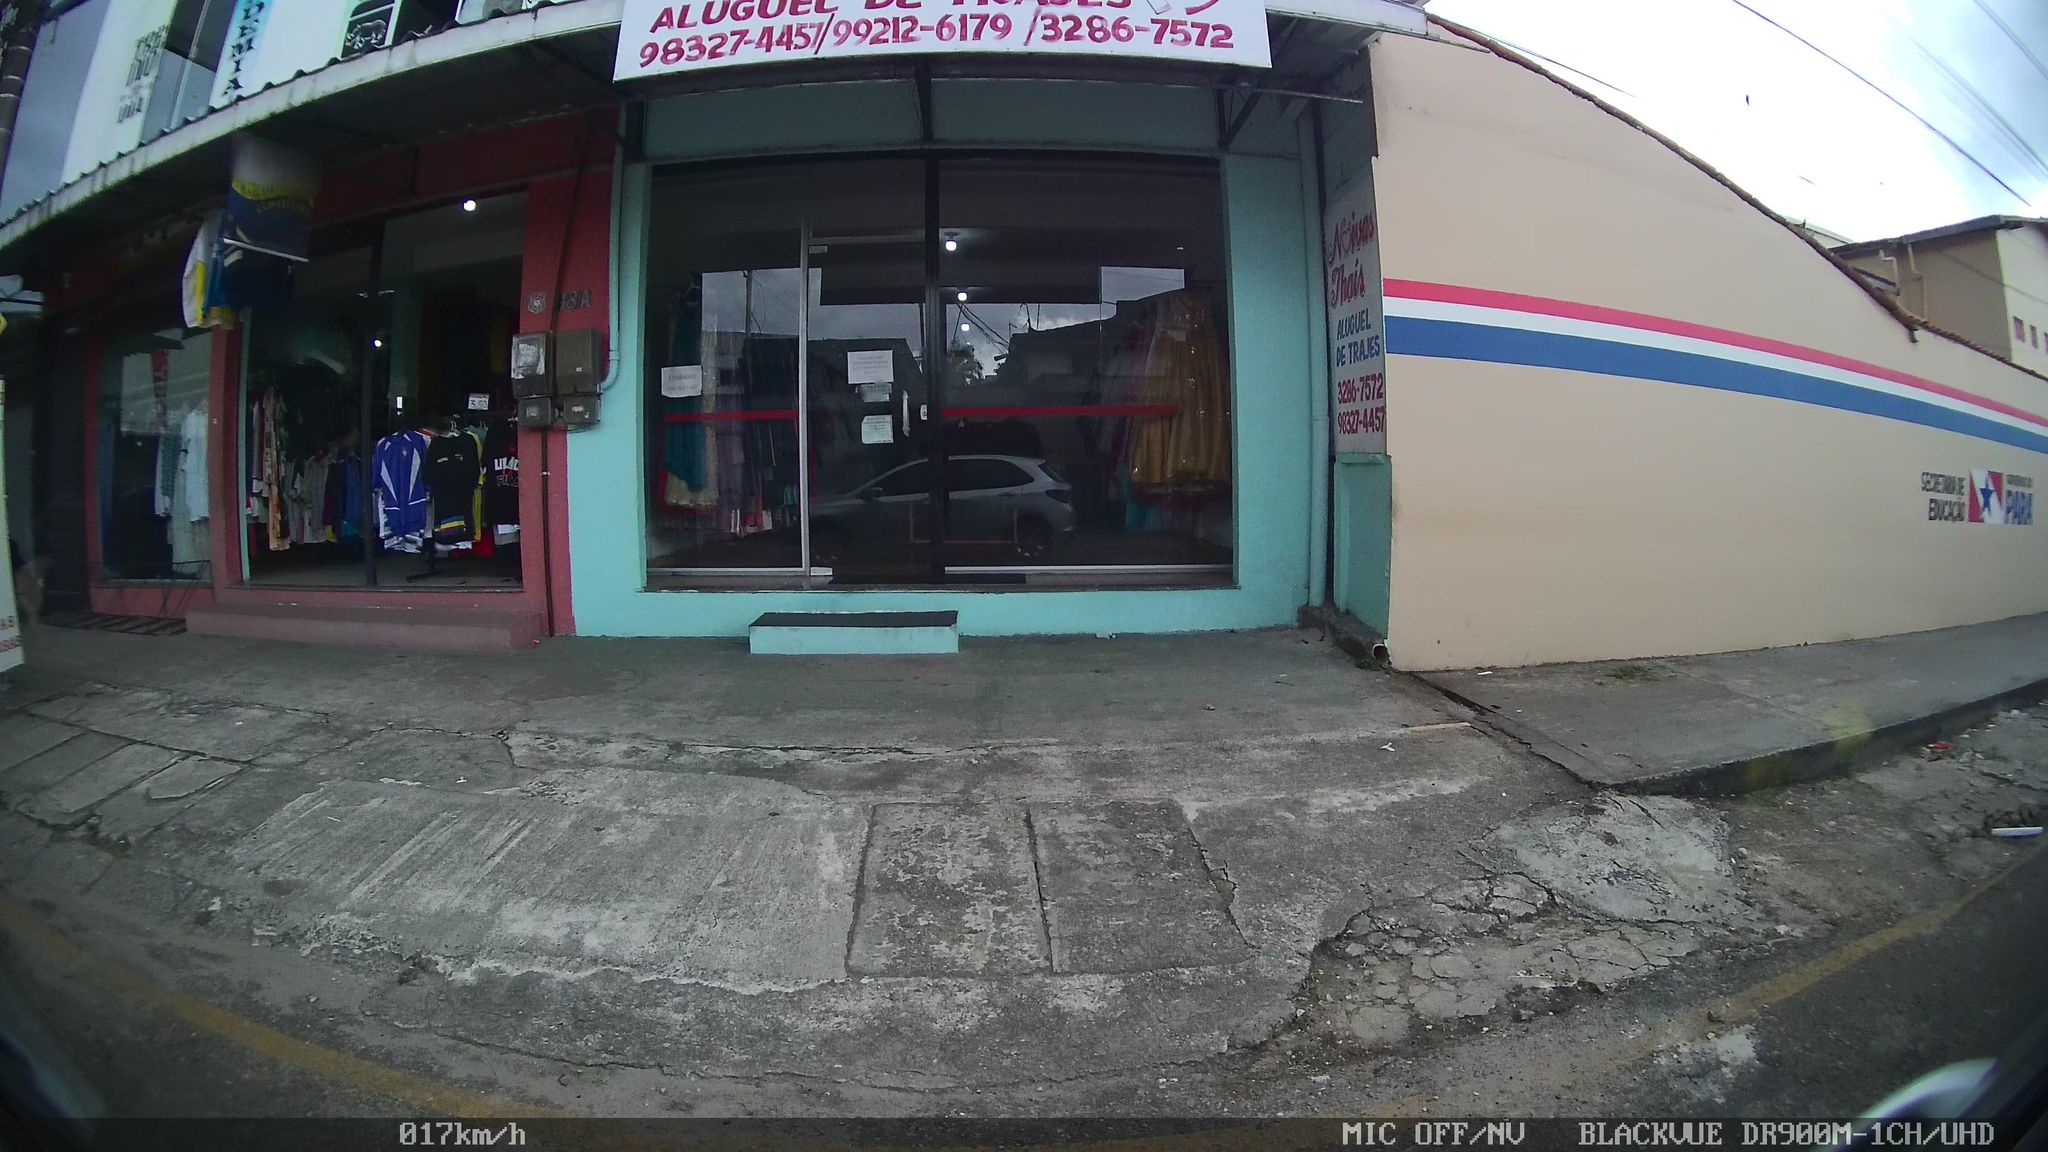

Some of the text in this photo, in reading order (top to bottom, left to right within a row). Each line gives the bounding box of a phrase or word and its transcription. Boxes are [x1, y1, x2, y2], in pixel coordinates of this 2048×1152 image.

[1337, 308, 1371, 340] ALUGUEL
[1337, 334, 1380, 367] DE TRAJES
[1338, 373, 1384, 404] 3286-7572
[1338, 405, 1385, 435] 98327-4457
